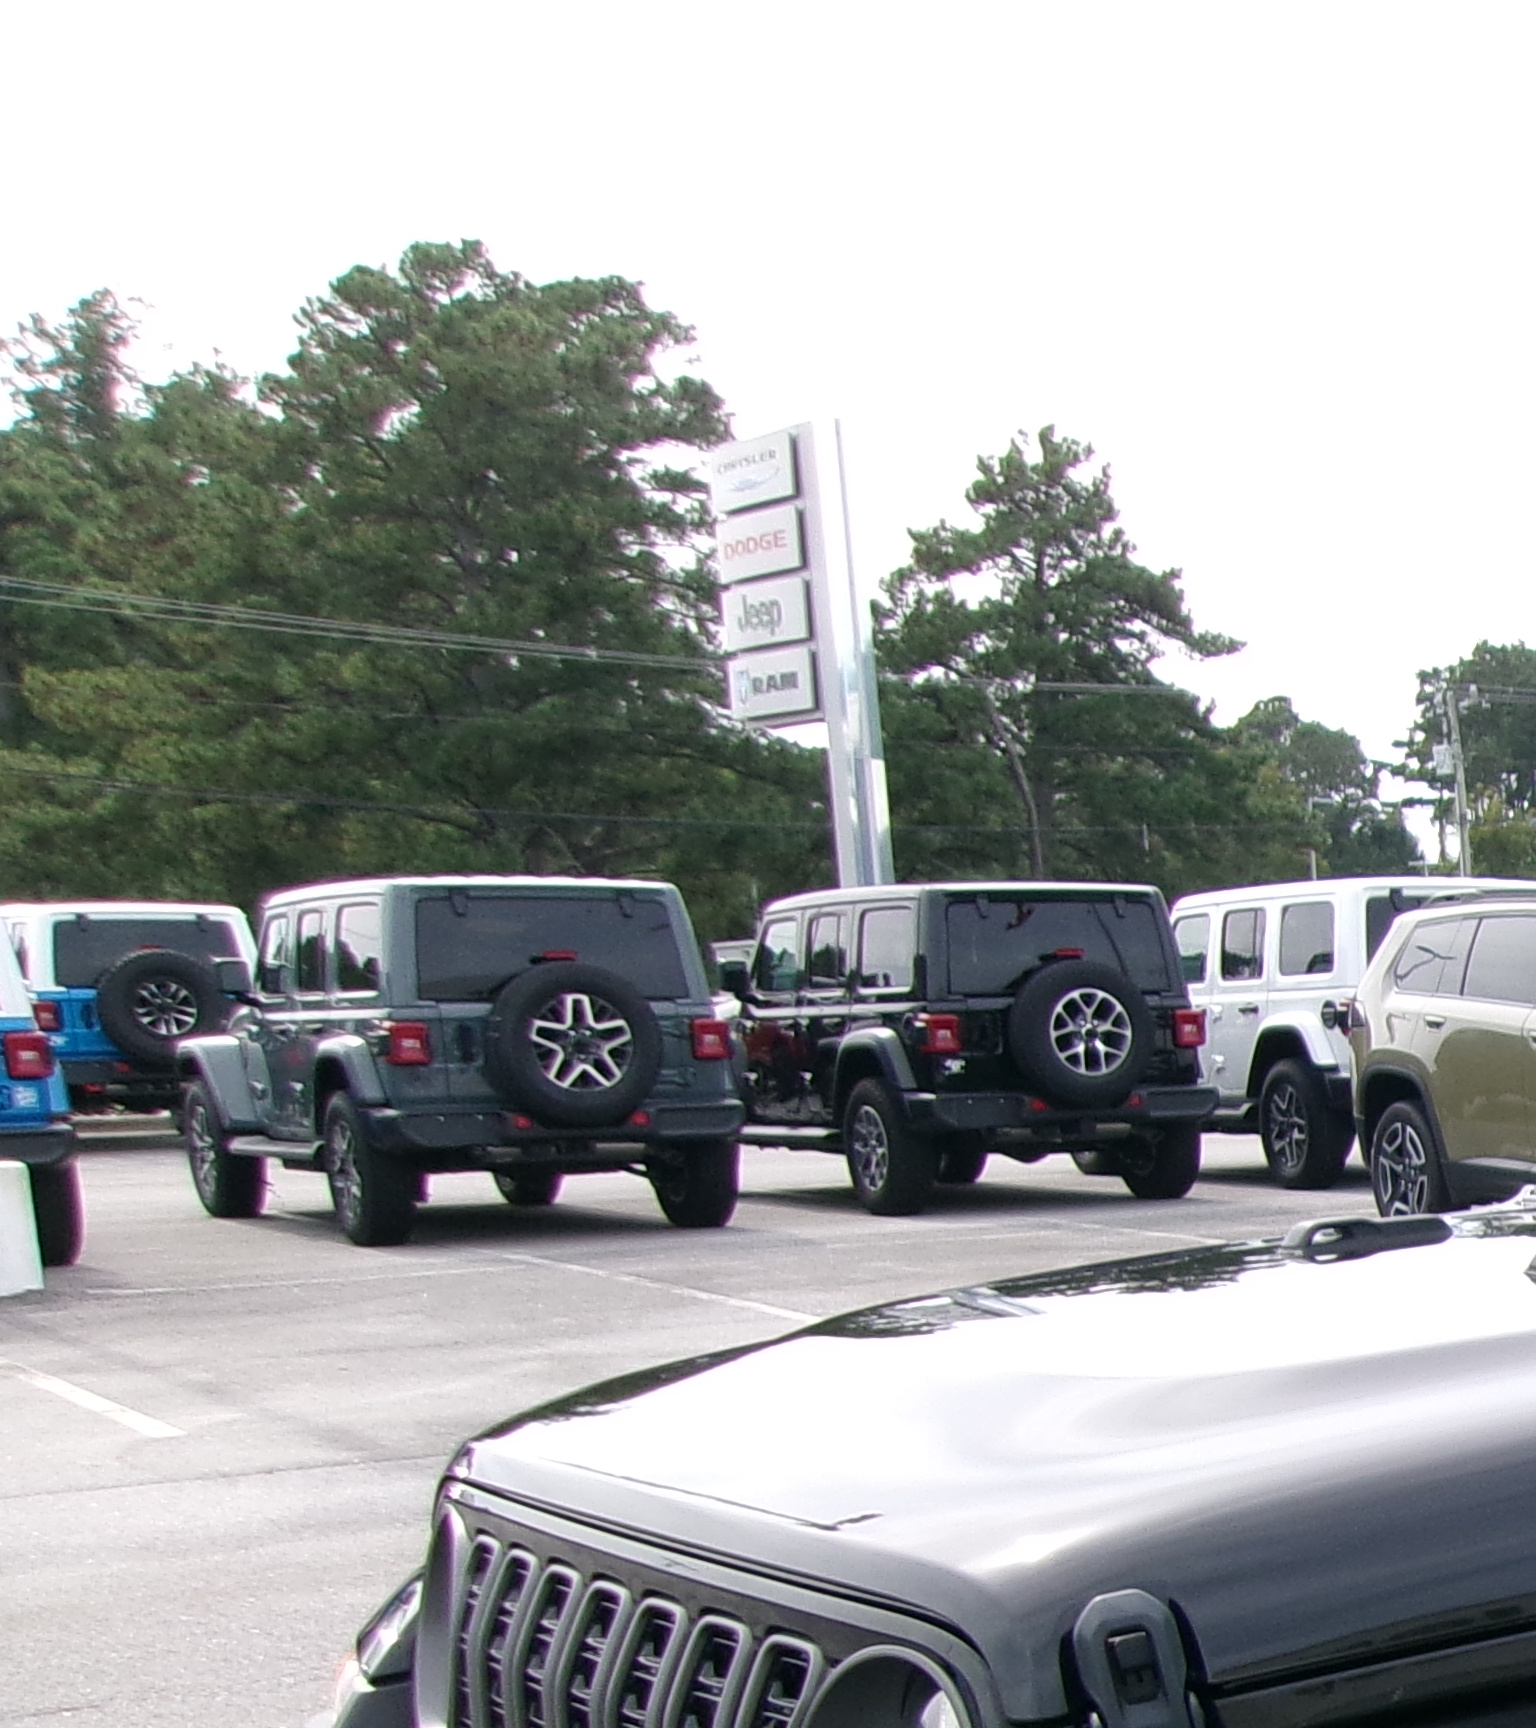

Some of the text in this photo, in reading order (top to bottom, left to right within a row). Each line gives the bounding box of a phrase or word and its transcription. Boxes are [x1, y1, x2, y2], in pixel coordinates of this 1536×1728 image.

[724, 529, 787, 560] DODGE
[738, 594, 782, 636] Jeep
[752, 669, 799, 695] RAM
